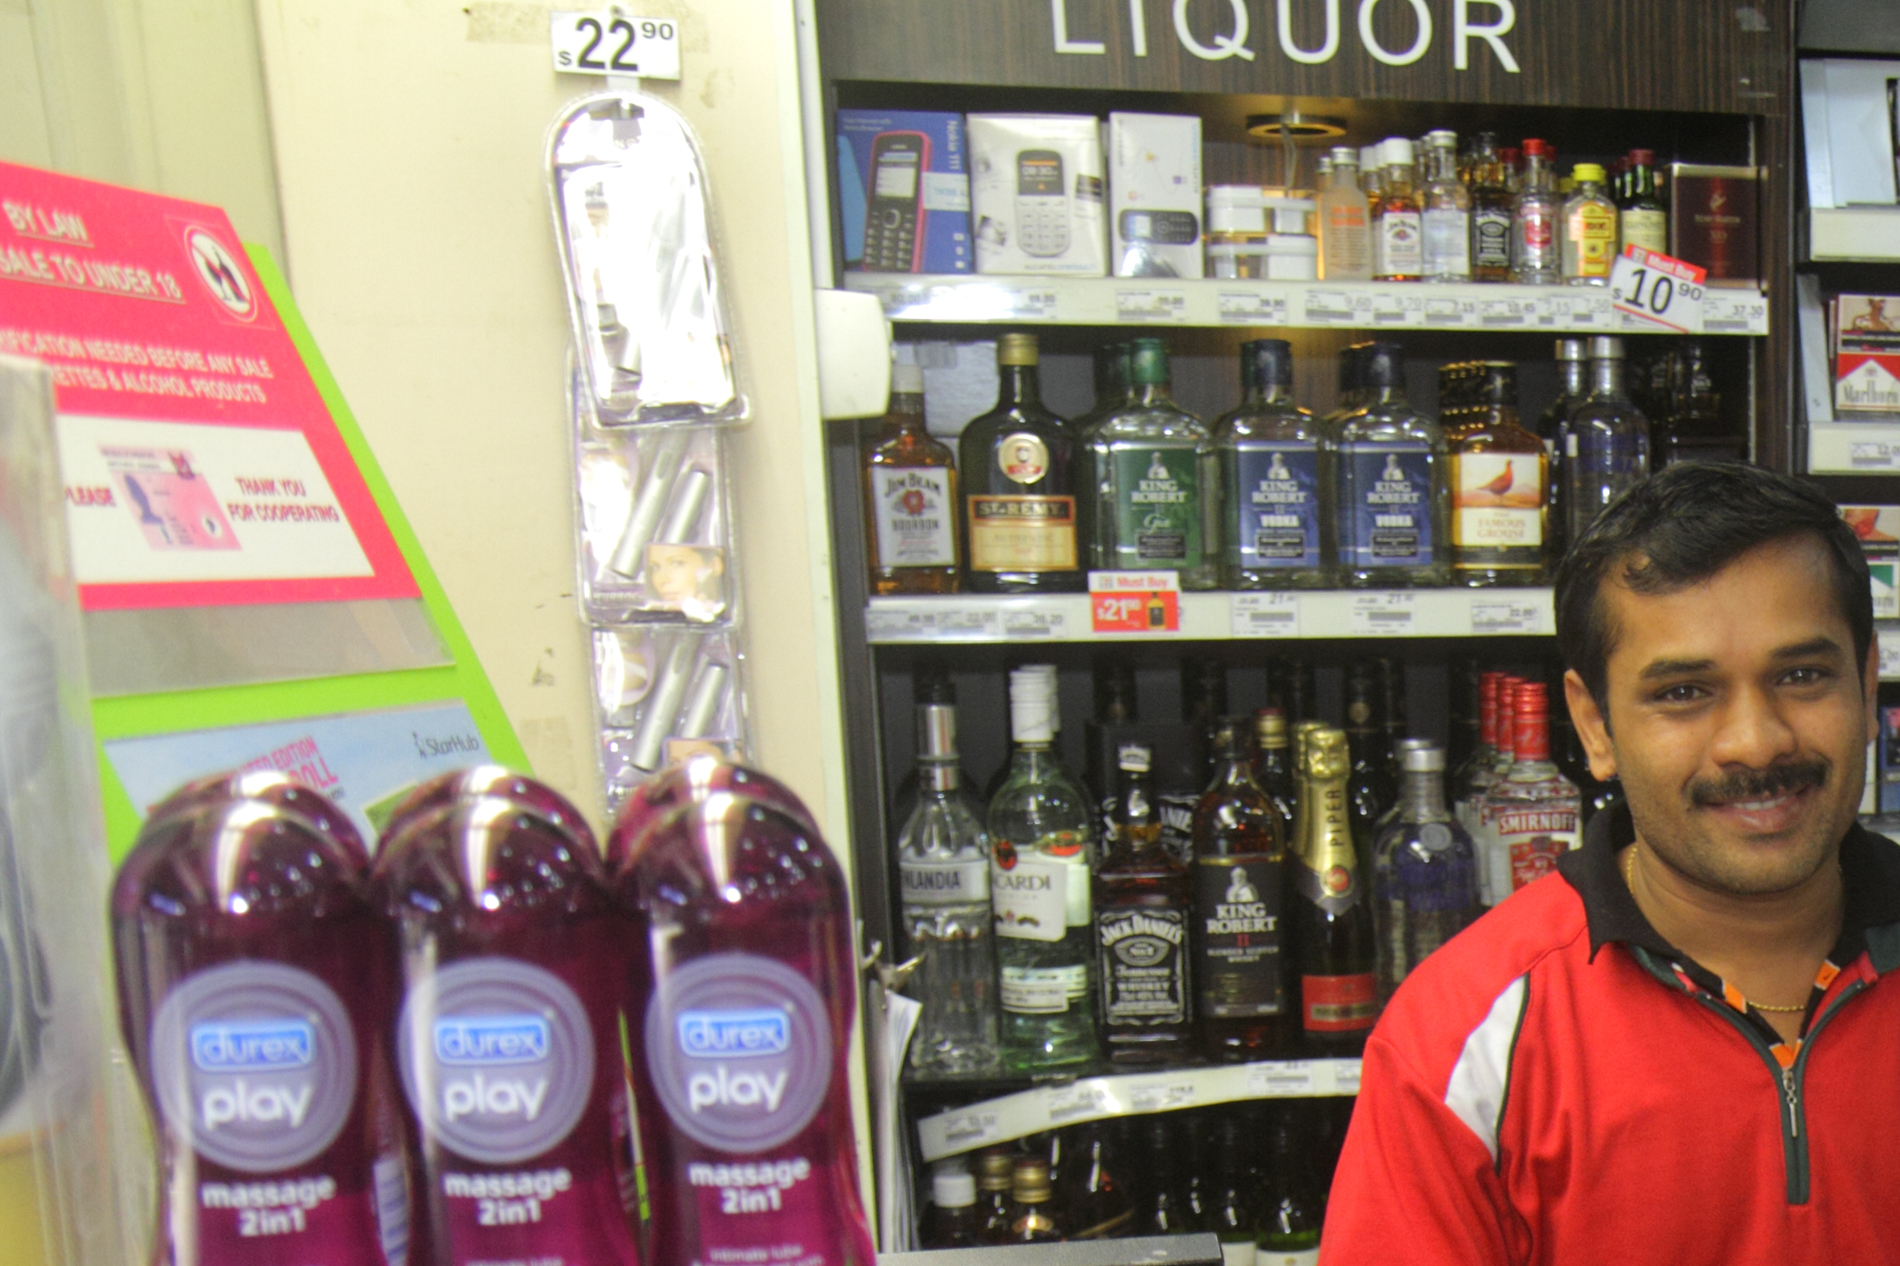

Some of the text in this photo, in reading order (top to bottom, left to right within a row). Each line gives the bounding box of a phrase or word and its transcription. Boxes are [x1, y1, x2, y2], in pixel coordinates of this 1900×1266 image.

[1053, 0, 1520, 73] LIQUOR
[5, 202, 87, 240] BY LAW
[53, 255, 181, 299] TO UNDER 18
[85, 340, 273, 378] NEEDED BEFORE ANY SALE
[124, 374, 266, 403] ALCOHOL PRODUCTS
[236, 478, 306, 497] THANK YOU
[908, 473, 941, 495] BEAM
[1131, 491, 1186, 504] ROBERT
[1139, 480, 1177, 492] KING
[1253, 492, 1307, 504] ROBERT
[1259, 480, 1299, 493] KING
[1375, 481, 1412, 494] KING
[1367, 492, 1421, 505] ROBERT
[227, 504, 339, 523] FOR COOPERATING
[427, 735, 479, 758] StarHub
[1330, 789, 1342, 848] PIPER
[1500, 811, 1576, 833] SMIRNOFF
[1216, 904, 1266, 918] KING
[1102, 920, 1130, 945] JACK
[1207, 917, 1277, 934] ROBERT
[443, 1029, 541, 1057] durex
[689, 1018, 781, 1047] durex
[203, 1032, 301, 1063] durex
[443, 1074, 548, 1120] play
[689, 1065, 789, 1112] play
[205, 1079, 314, 1130] play
[444, 1167, 573, 1199] massage
[689, 1157, 811, 1190] massage
[202, 1175, 337, 1209] massage
[720, 1188, 782, 1214] 2in1
[239, 1209, 306, 1237] 2in1
[479, 1197, 542, 1226] 2in1
